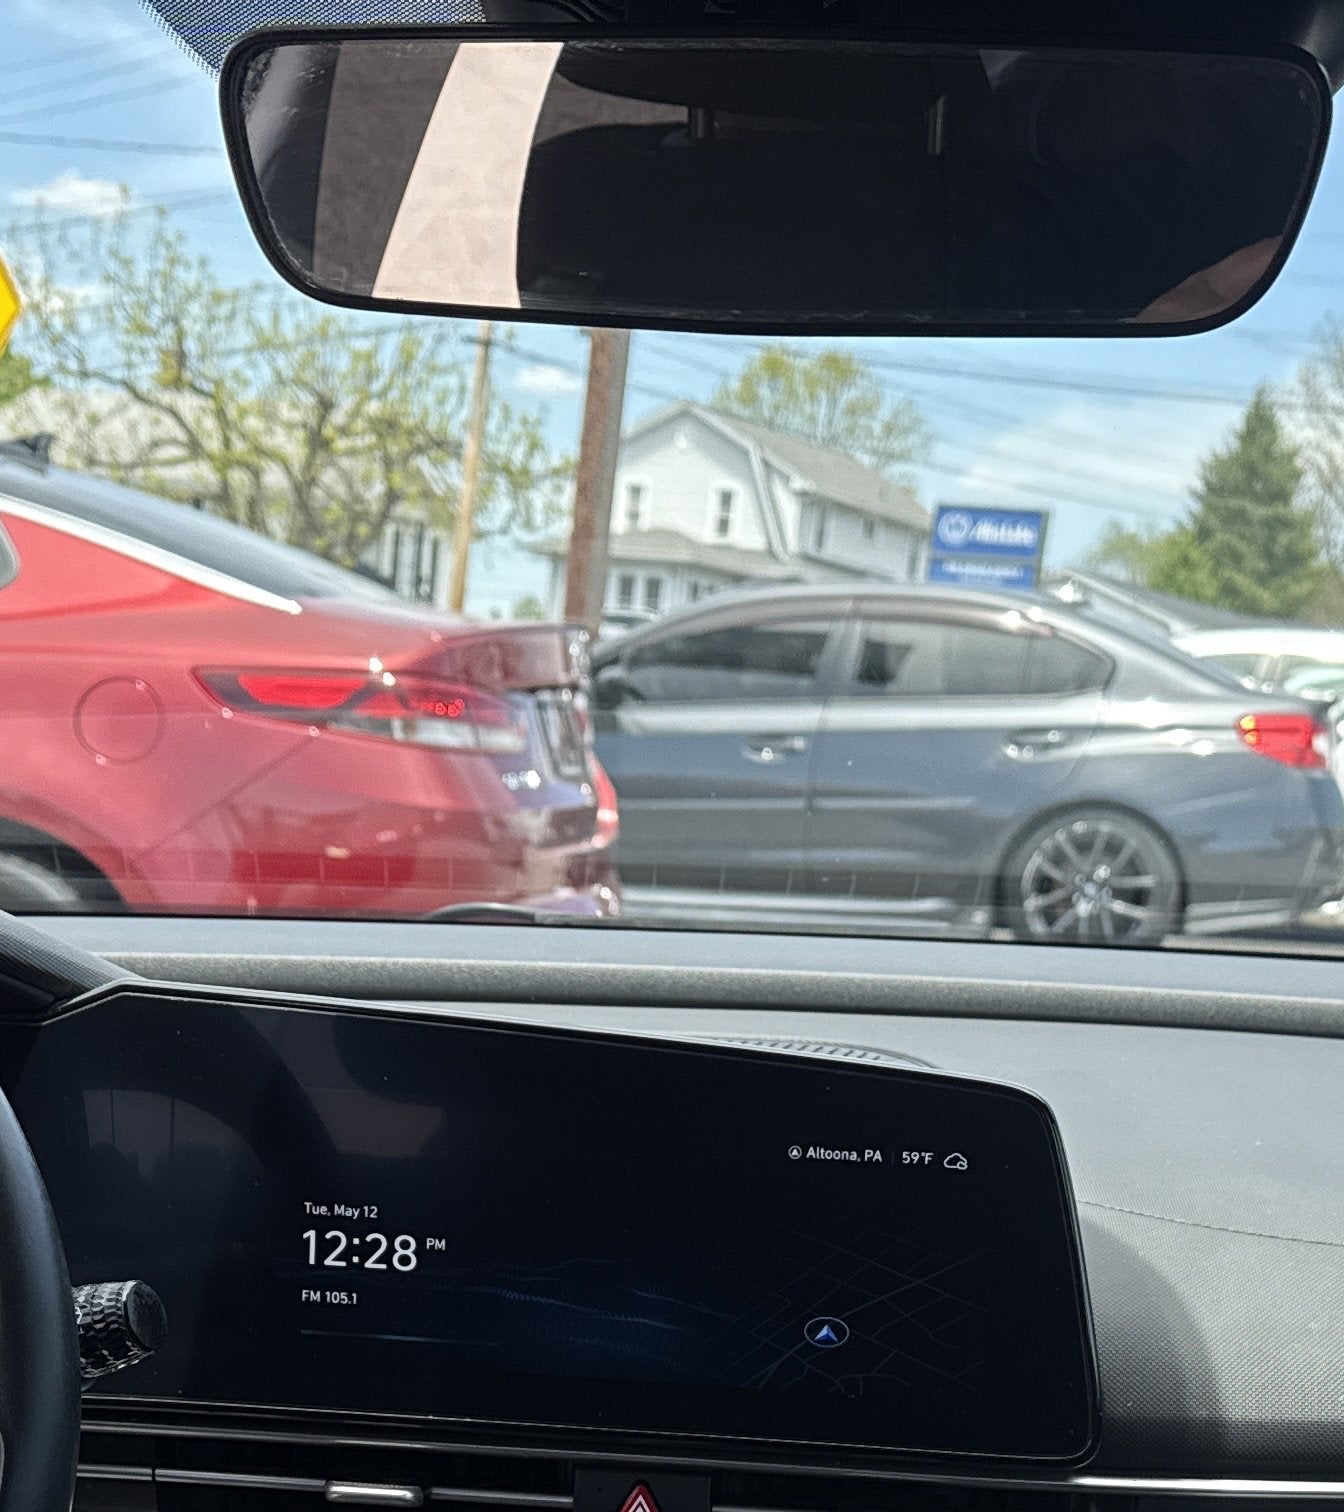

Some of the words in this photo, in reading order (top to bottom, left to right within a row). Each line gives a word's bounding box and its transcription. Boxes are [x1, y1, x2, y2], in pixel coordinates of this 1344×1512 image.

[806, 1146, 861, 1163] Altoona,
[864, 1149, 883, 1163] PA
[902, 1151, 934, 1165] 59°F
[304, 1202, 331, 1217] Tue,
[334, 1204, 359, 1220] May
[363, 1205, 378, 1219] 12
[302, 1229, 418, 1272] 12:28
[426, 1238, 446, 1251] PM
[302, 1290, 321, 1303] FM
[325, 1291, 358, 1305] 105.1
